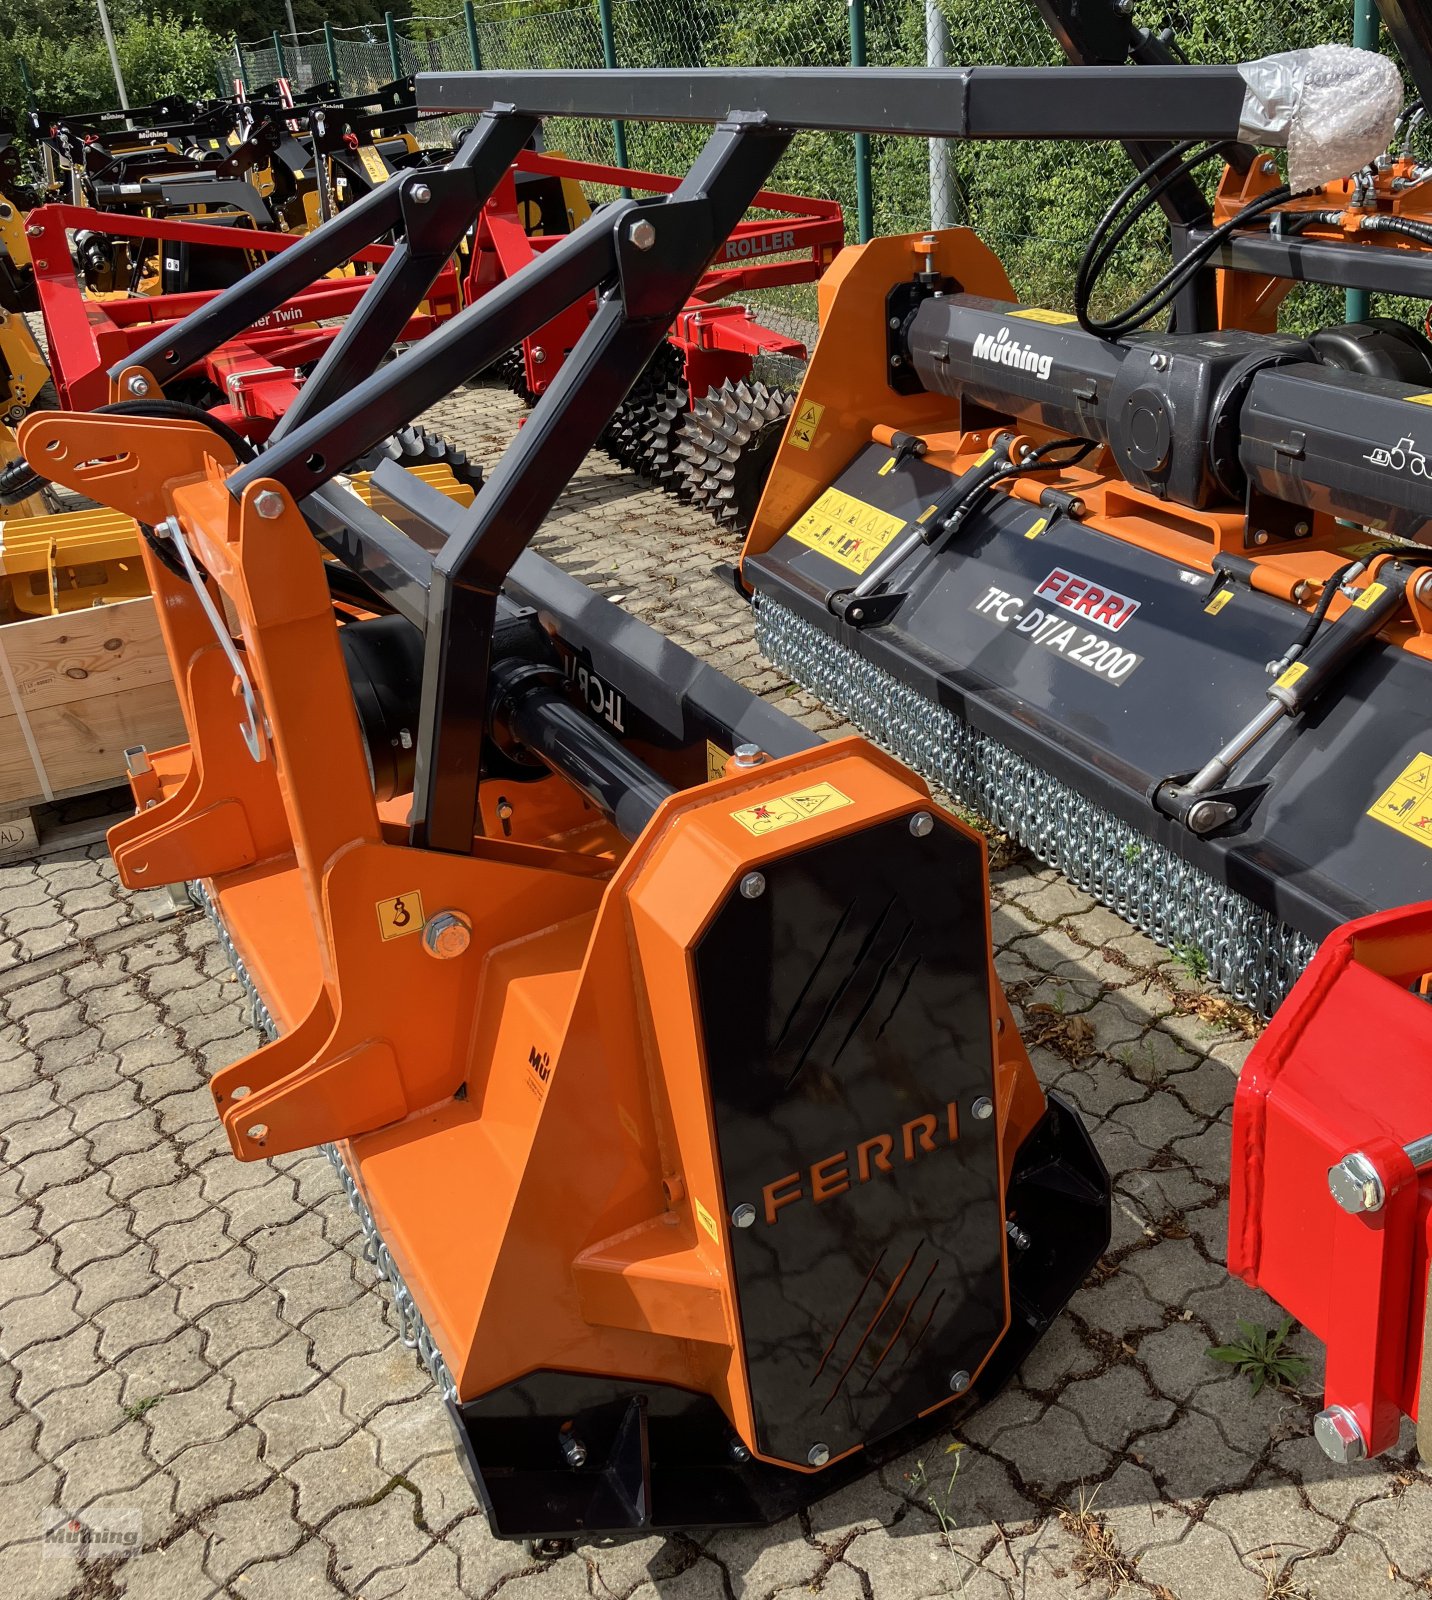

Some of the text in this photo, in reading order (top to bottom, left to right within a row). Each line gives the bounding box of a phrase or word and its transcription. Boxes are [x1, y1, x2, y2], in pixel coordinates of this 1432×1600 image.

[139, 130, 168, 139] Müthing
[725, 231, 795, 258] ROLLER
[272, 307, 303, 322] Twin
[972, 327, 1054, 380] Müthing
[1037, 570, 1137, 630] FERRI
[975, 586, 1137, 679] TFC-DT/A 2200
[762, 1101, 960, 1225] FERRI
